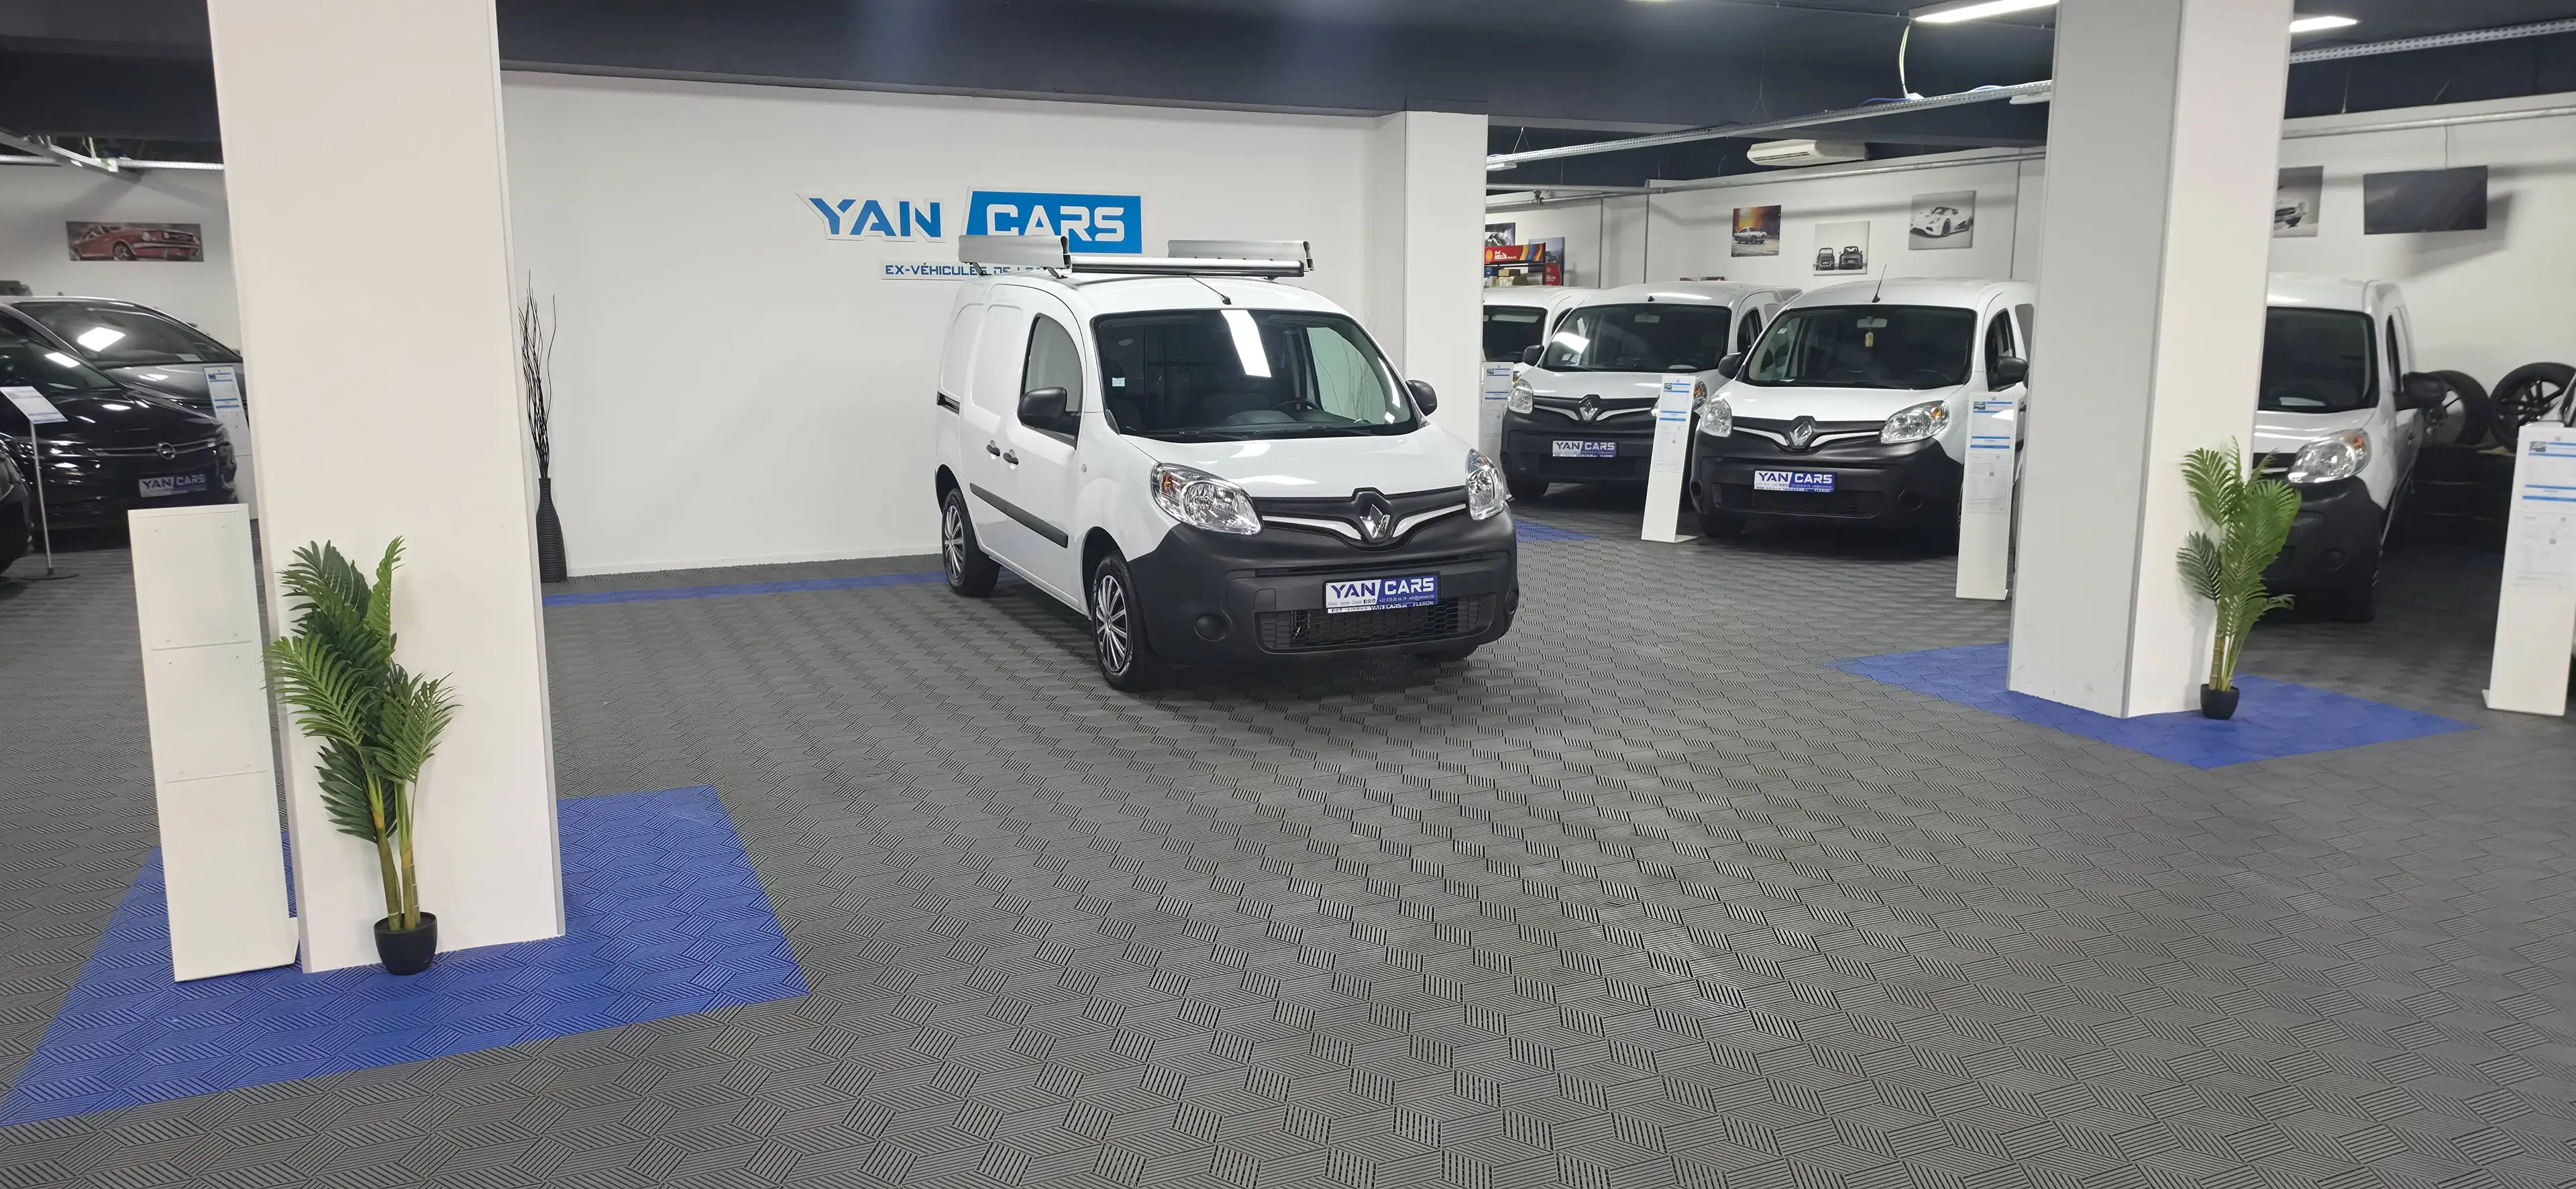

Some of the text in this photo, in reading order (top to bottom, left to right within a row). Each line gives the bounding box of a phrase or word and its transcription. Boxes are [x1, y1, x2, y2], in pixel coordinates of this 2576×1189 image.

[808, 197, 1125, 242] YAN CARS
[1585, 442, 1615, 450] CARS
[1758, 472, 1832, 483] YAN CARS
[142, 478, 171, 489] YAN
[1331, 577, 1434, 599] YAN CARS
